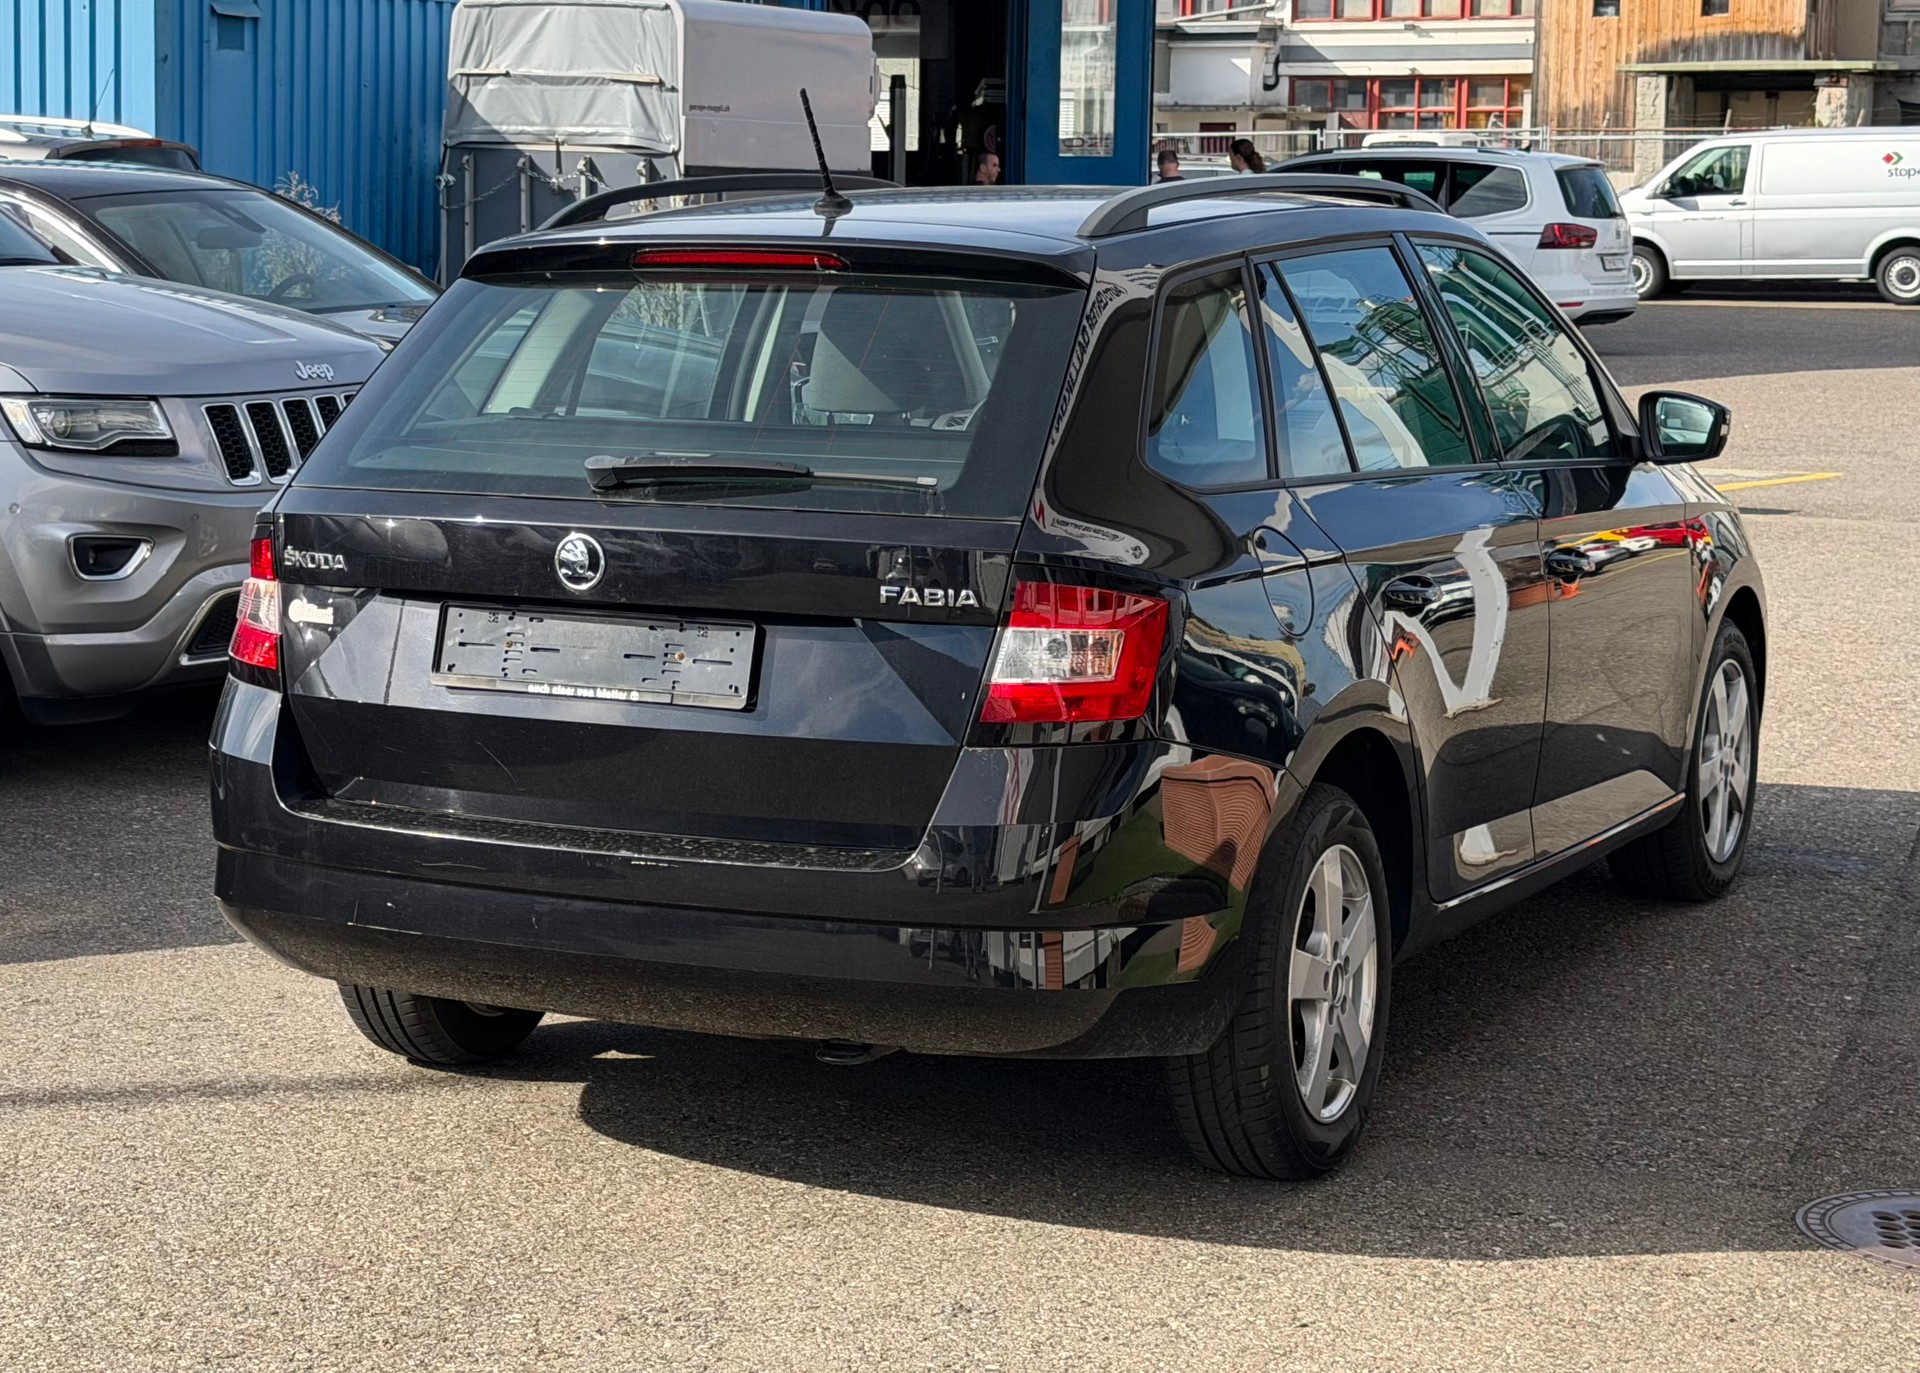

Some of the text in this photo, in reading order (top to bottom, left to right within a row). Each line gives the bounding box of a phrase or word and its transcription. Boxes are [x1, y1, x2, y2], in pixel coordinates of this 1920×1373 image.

[295, 360, 334, 381] Jeep
[284, 545, 348, 571] ŠKODA
[880, 585, 980, 608] FABIA
[527, 684, 550, 694] auch
[552, 685, 575, 696] einer
[577, 688, 594, 697] von
